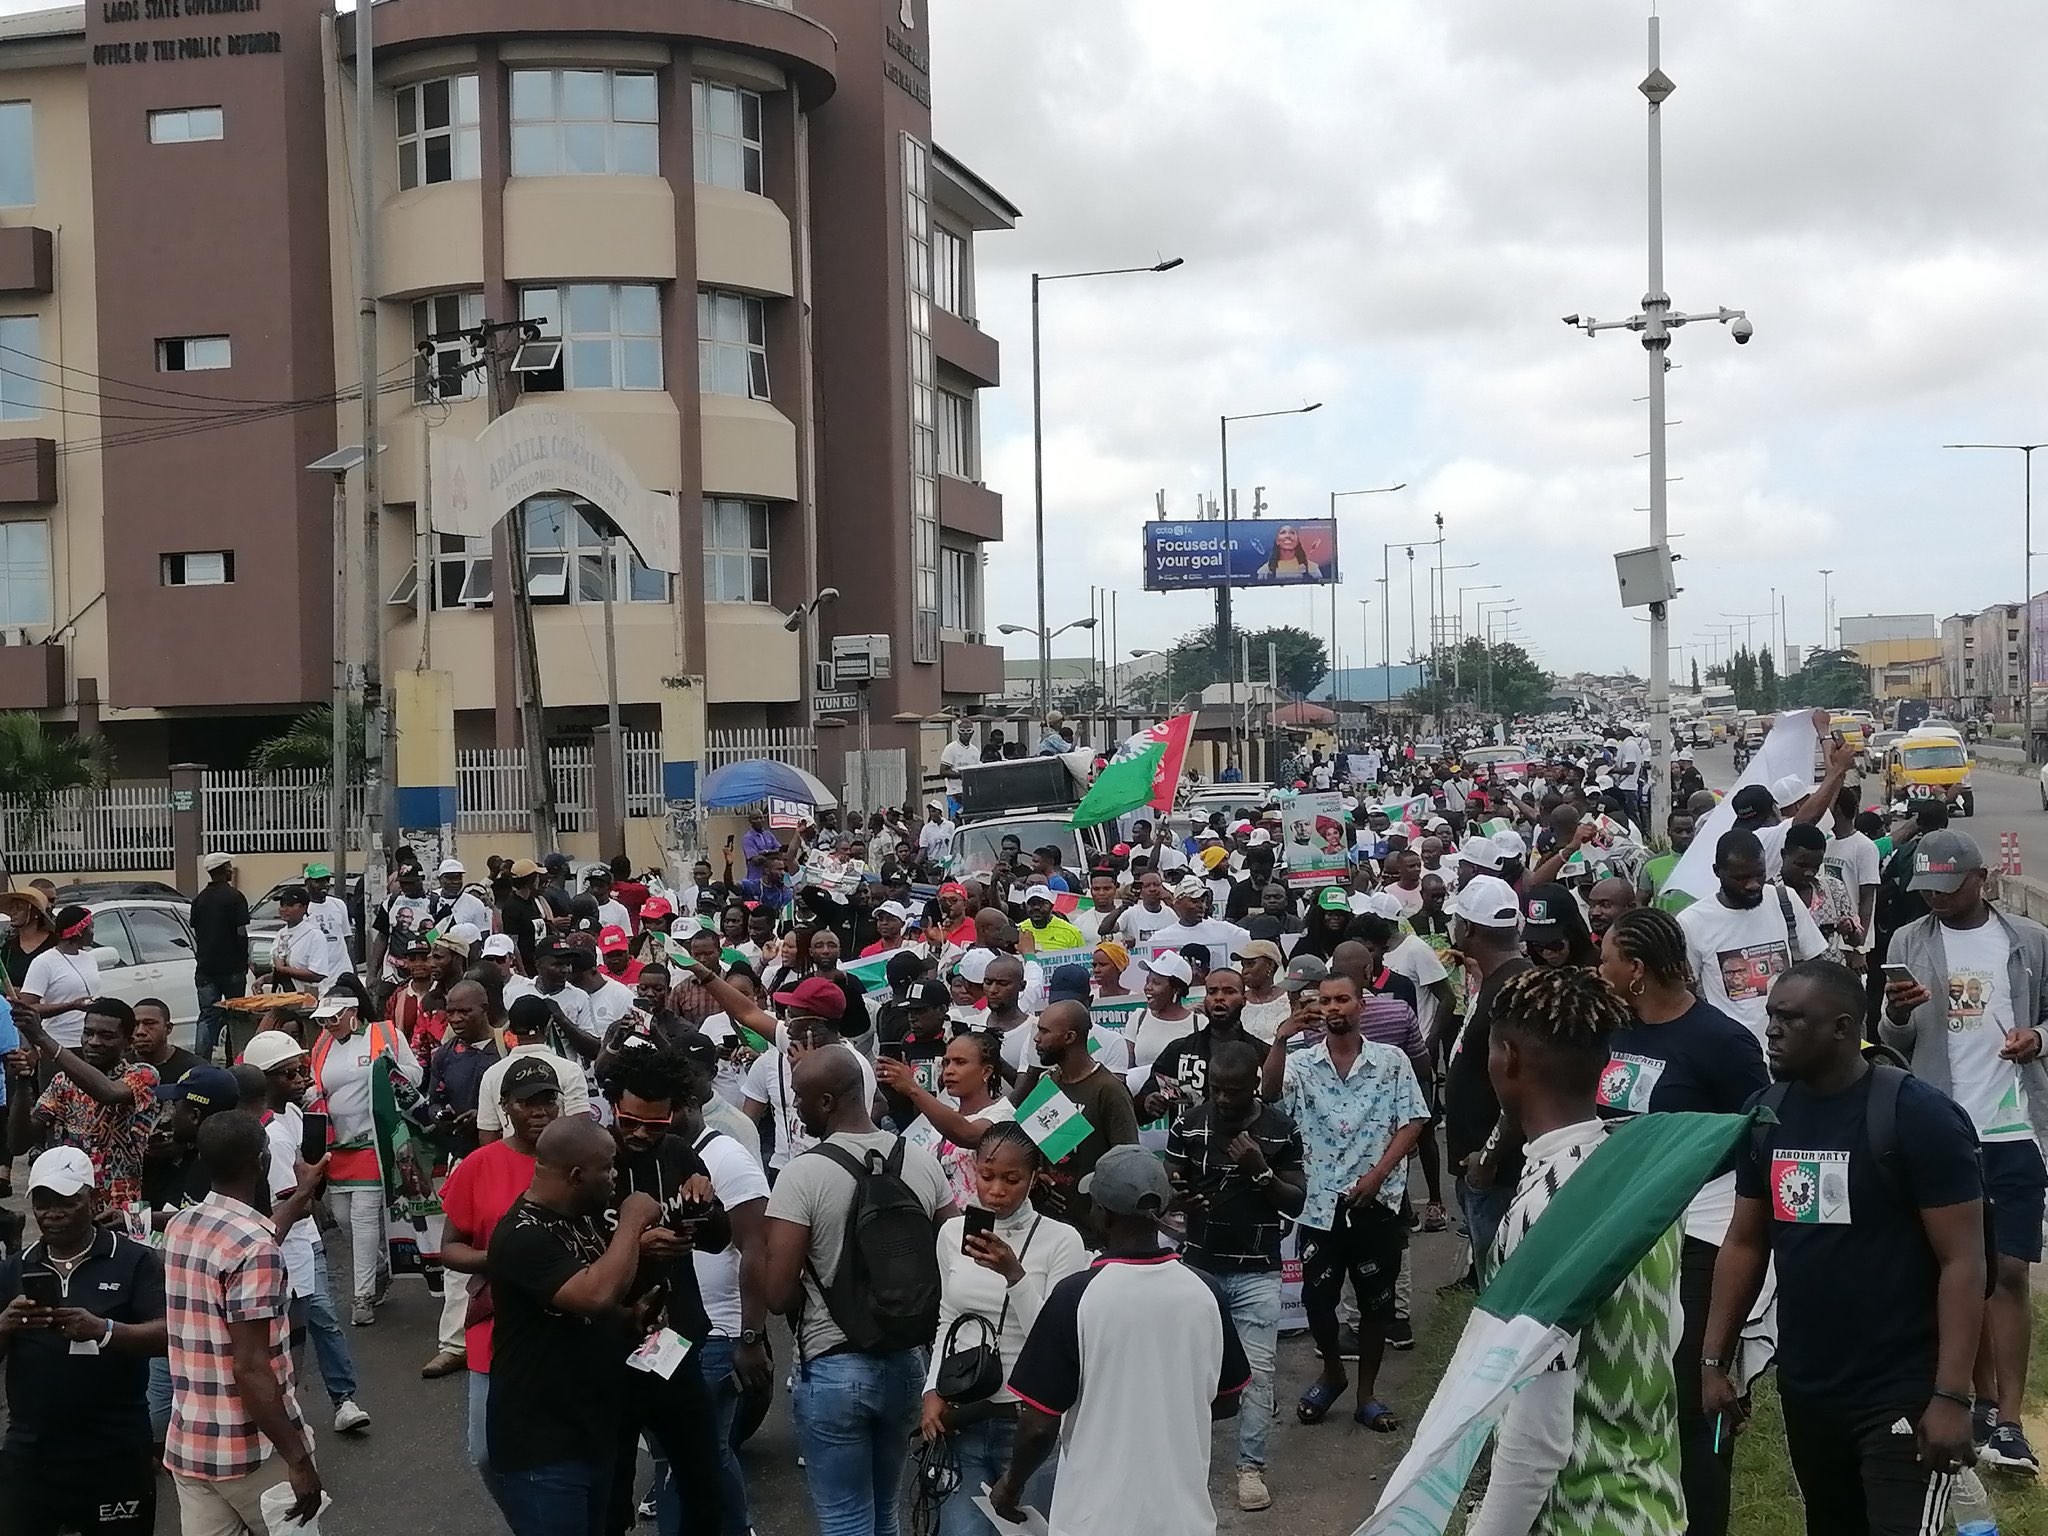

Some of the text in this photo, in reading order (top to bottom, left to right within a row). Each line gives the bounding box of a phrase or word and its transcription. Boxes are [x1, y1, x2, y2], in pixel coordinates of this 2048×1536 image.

[103, 2, 140, 24] LAGOS
[145, 0, 180, 20] STATE
[93, 31, 282, 66] OFFICE OF THE PUBLIC DEFENDER
[552, 435, 631, 506] COMMUNITY
[505, 468, 618, 514] DEVELOPMENT ASSOCIATION
[1156, 537, 1218, 552] Focused
[1156, 552, 1223, 571] your goal
[815, 695, 858, 710] IYUN RD
[773, 799, 810, 817] POS
[1091, 1010, 1127, 1024] UPPORT
[1775, 1150, 1816, 1161] LABOUR
[99, 1500, 140, 1517] EA7
